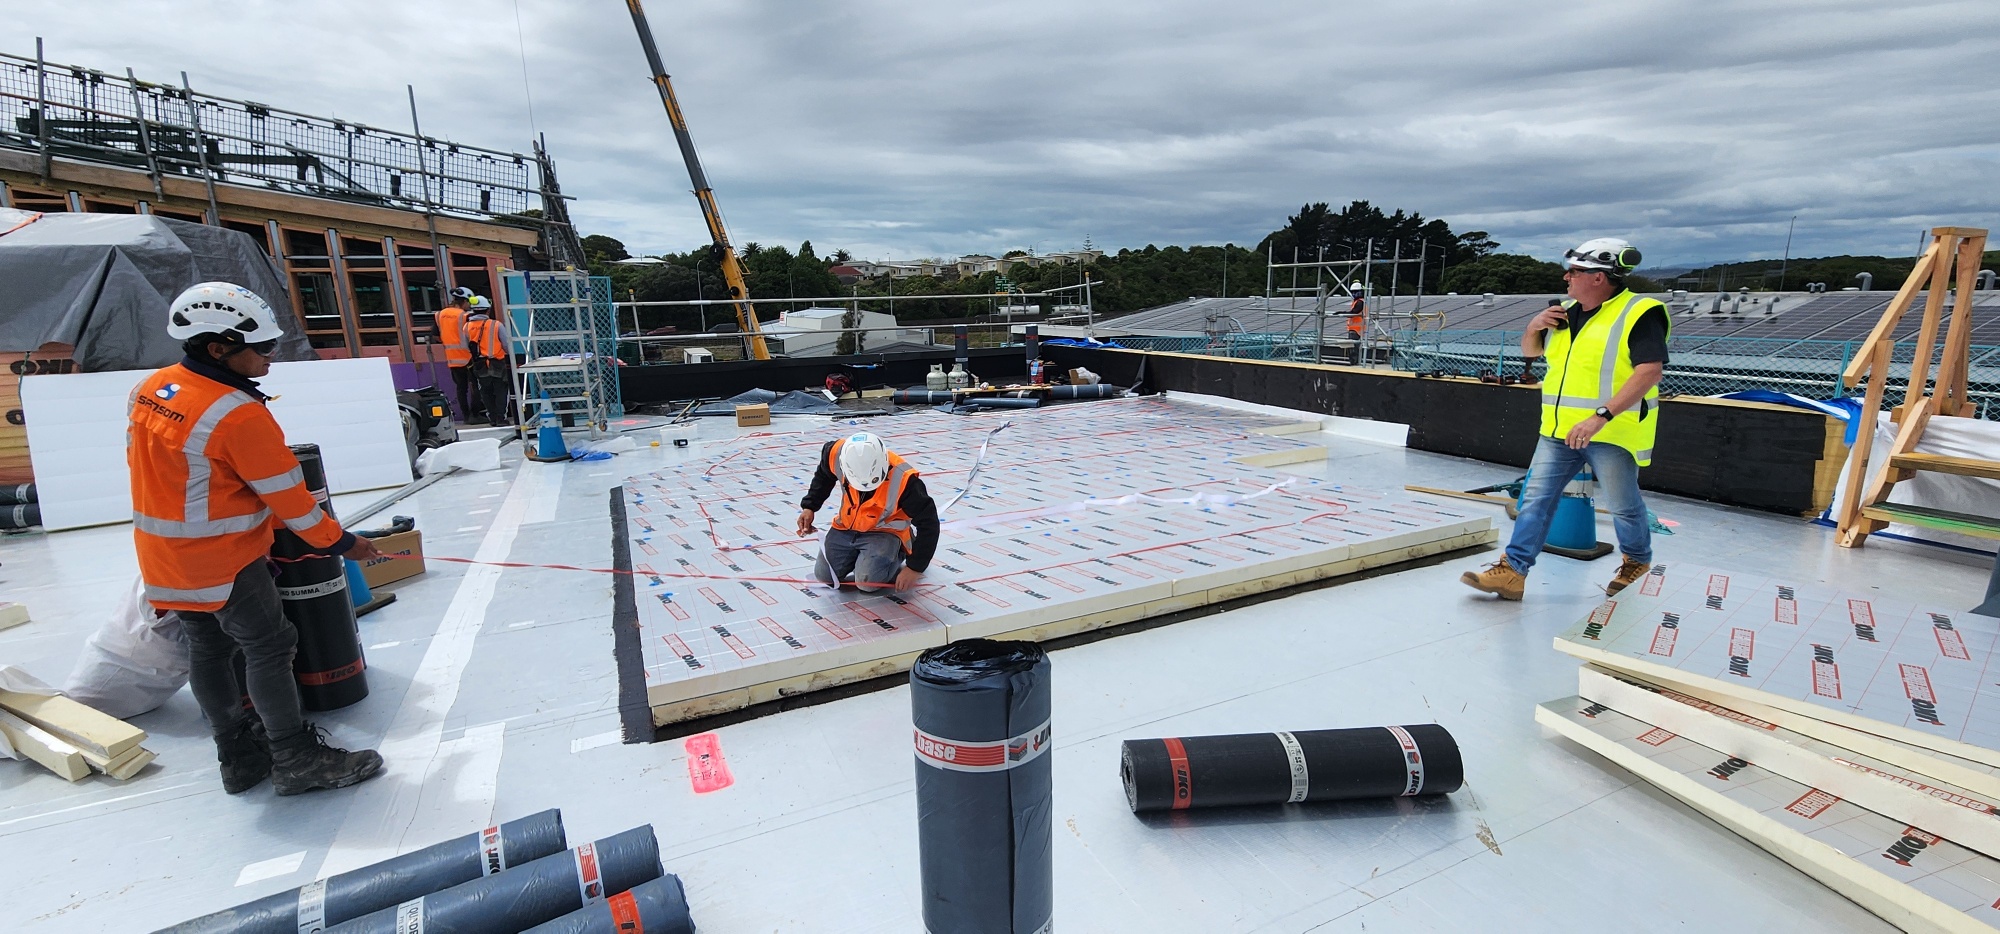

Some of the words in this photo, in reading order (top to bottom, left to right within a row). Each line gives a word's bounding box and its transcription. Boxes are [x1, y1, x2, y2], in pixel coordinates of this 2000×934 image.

[290, 588, 320, 597] SUMMA
[801, 609, 823, 621] IKO
[710, 624, 731, 638] IKO
[873, 618, 898, 631] IKO
[782, 635, 806, 649] IKO
[682, 654, 705, 670] IKO
[1729, 656, 1752, 678] IKO
[1912, 698, 1946, 726] IKO
[917, 736, 956, 761] base
[1707, 757, 1748, 781] IKO
[1882, 835, 1928, 867] IKO
